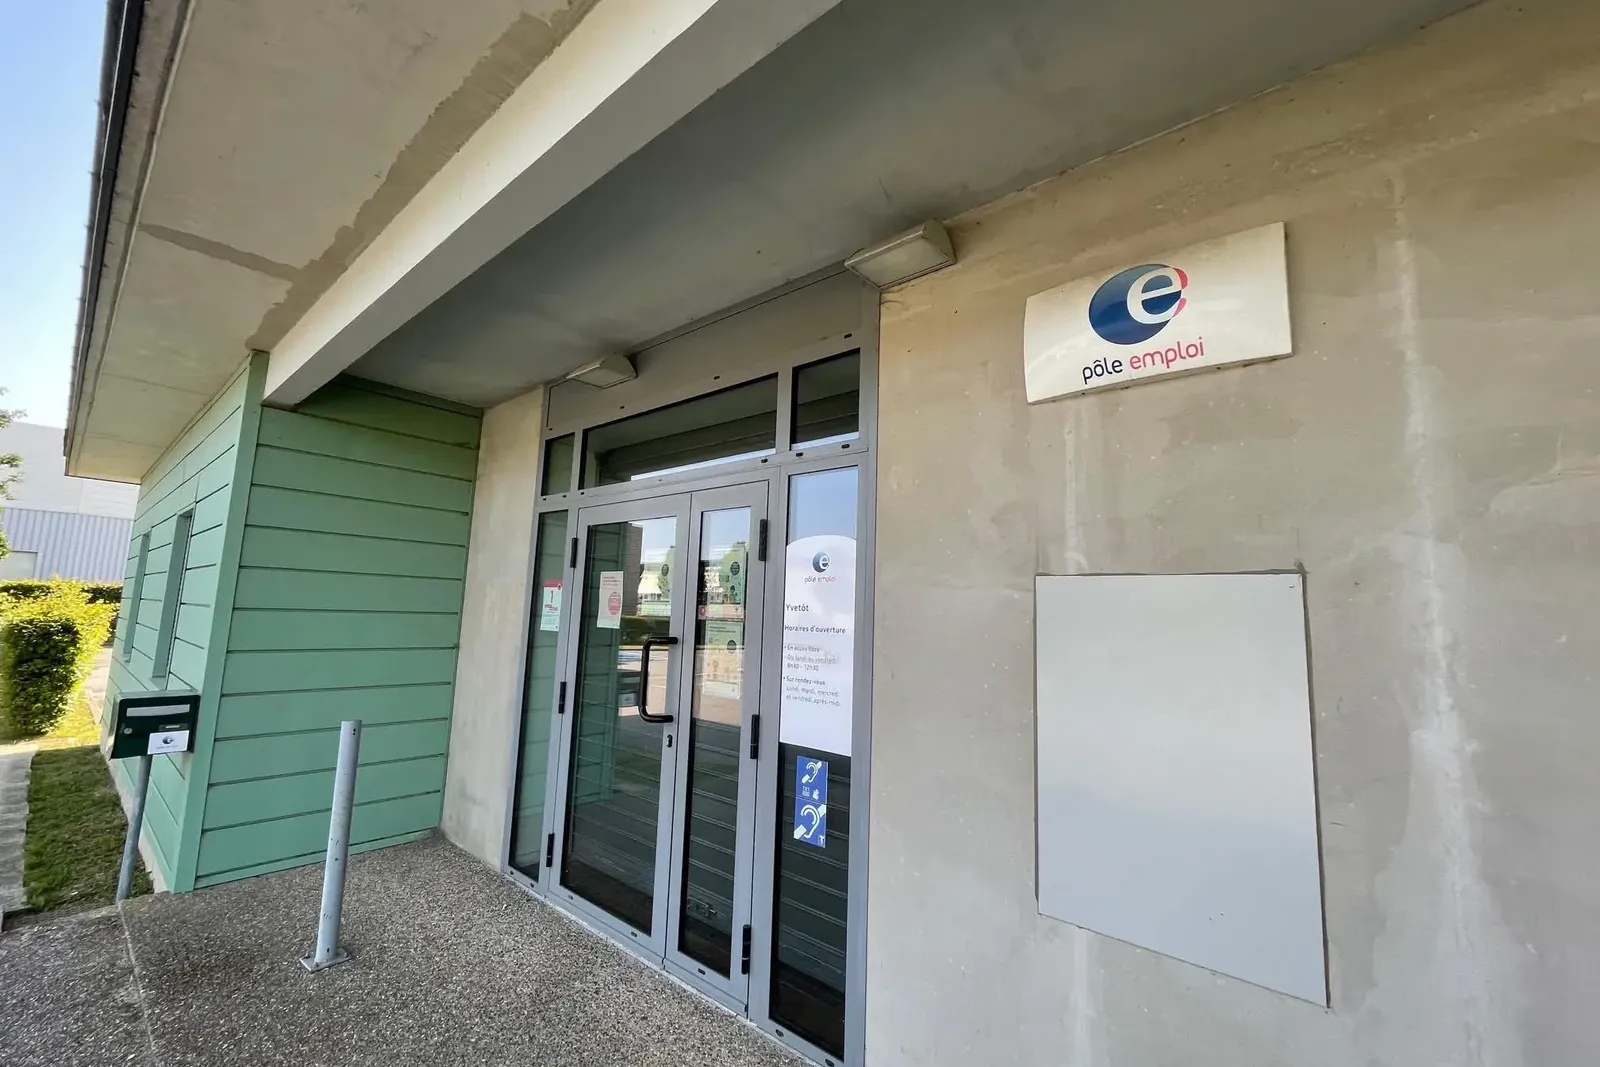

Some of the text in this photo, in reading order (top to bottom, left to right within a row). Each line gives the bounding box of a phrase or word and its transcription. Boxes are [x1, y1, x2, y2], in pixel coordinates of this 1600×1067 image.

[1082, 336, 1205, 385] pôle emploi
[786, 604, 810, 612] Yvetôt
[810, 625, 846, 634] d'ouverture
